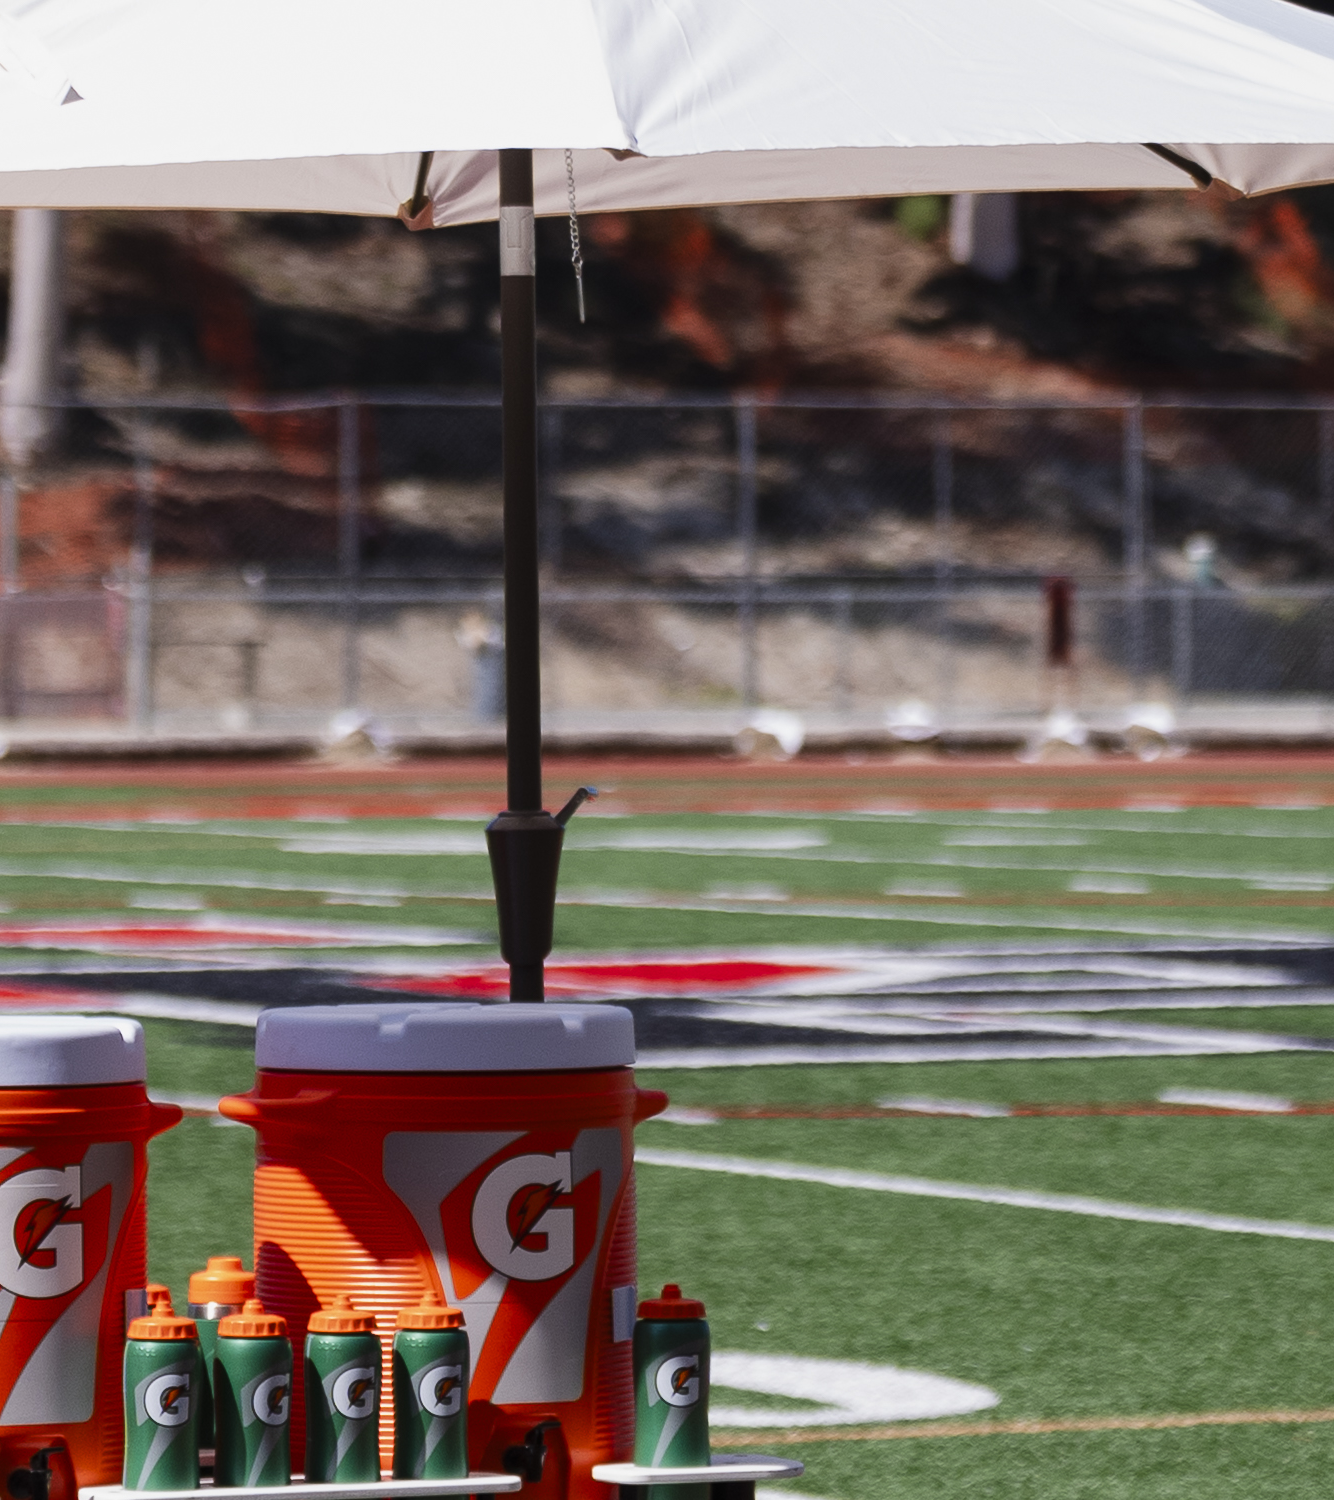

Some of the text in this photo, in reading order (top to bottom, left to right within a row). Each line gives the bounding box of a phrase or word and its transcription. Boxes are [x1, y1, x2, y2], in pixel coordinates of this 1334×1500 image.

[471, 1150, 574, 1281] G
[144, 1373, 191, 1428] G
[252, 1373, 290, 1427] G
[331, 1366, 375, 1420] G
[419, 1363, 463, 1418] G
[655, 1354, 700, 1408] G
